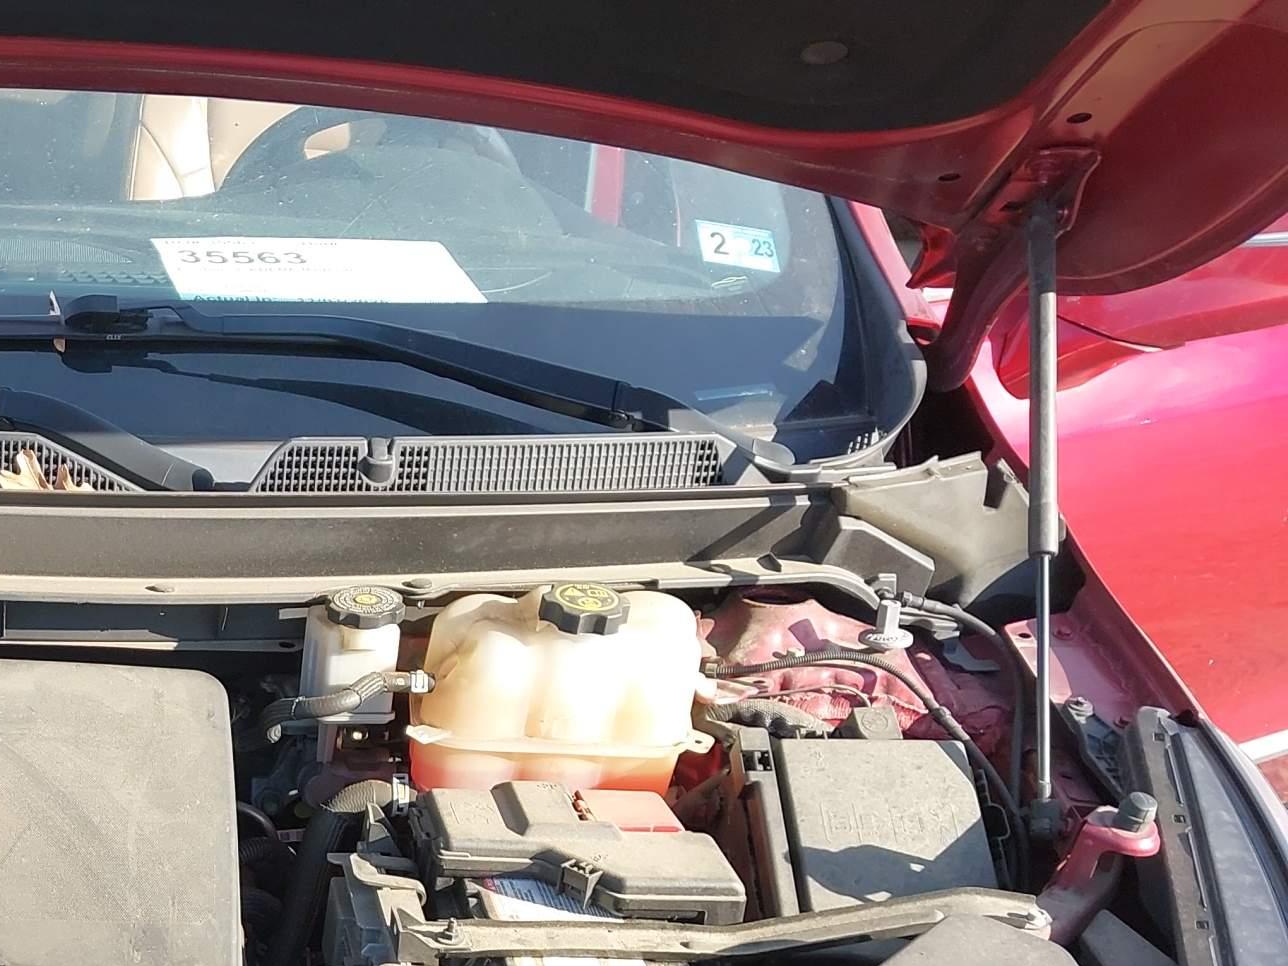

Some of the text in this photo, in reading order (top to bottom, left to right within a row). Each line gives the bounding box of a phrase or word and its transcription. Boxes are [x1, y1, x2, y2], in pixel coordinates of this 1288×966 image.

[710, 231, 775, 258] 2 23
[177, 250, 308, 264] 35563
